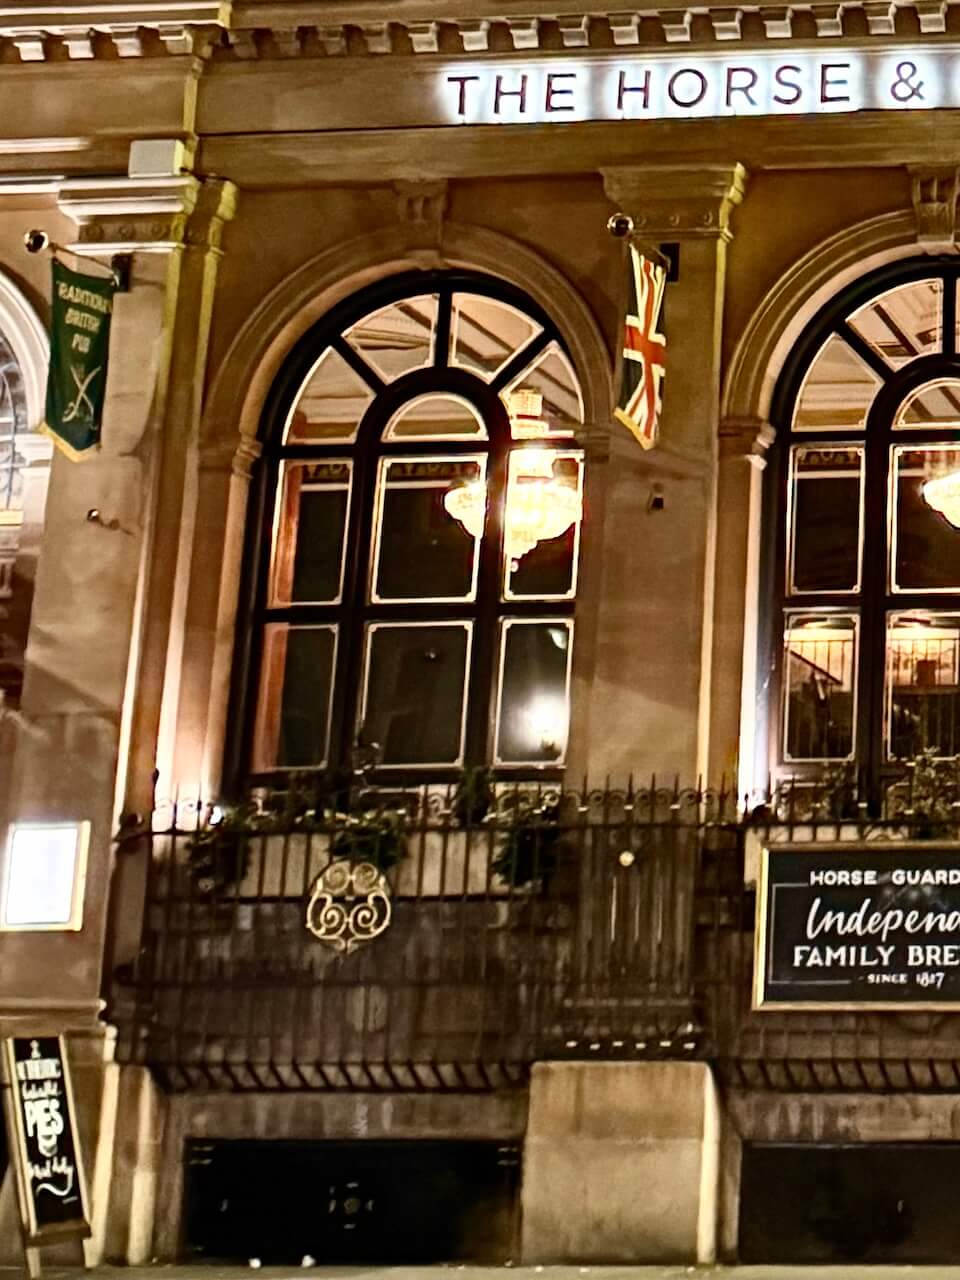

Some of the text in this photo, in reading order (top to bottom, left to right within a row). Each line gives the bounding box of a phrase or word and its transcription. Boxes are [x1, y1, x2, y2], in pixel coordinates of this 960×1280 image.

[447, 73, 577, 116] THE
[616, 63, 851, 110] HORSE
[889, 61, 926, 102] &
[56, 281, 112, 314] RADITIONA
[810, 870, 877, 886] HORSE
[793, 945, 896, 968] FAMILY
[867, 972, 908, 985] SINCE
